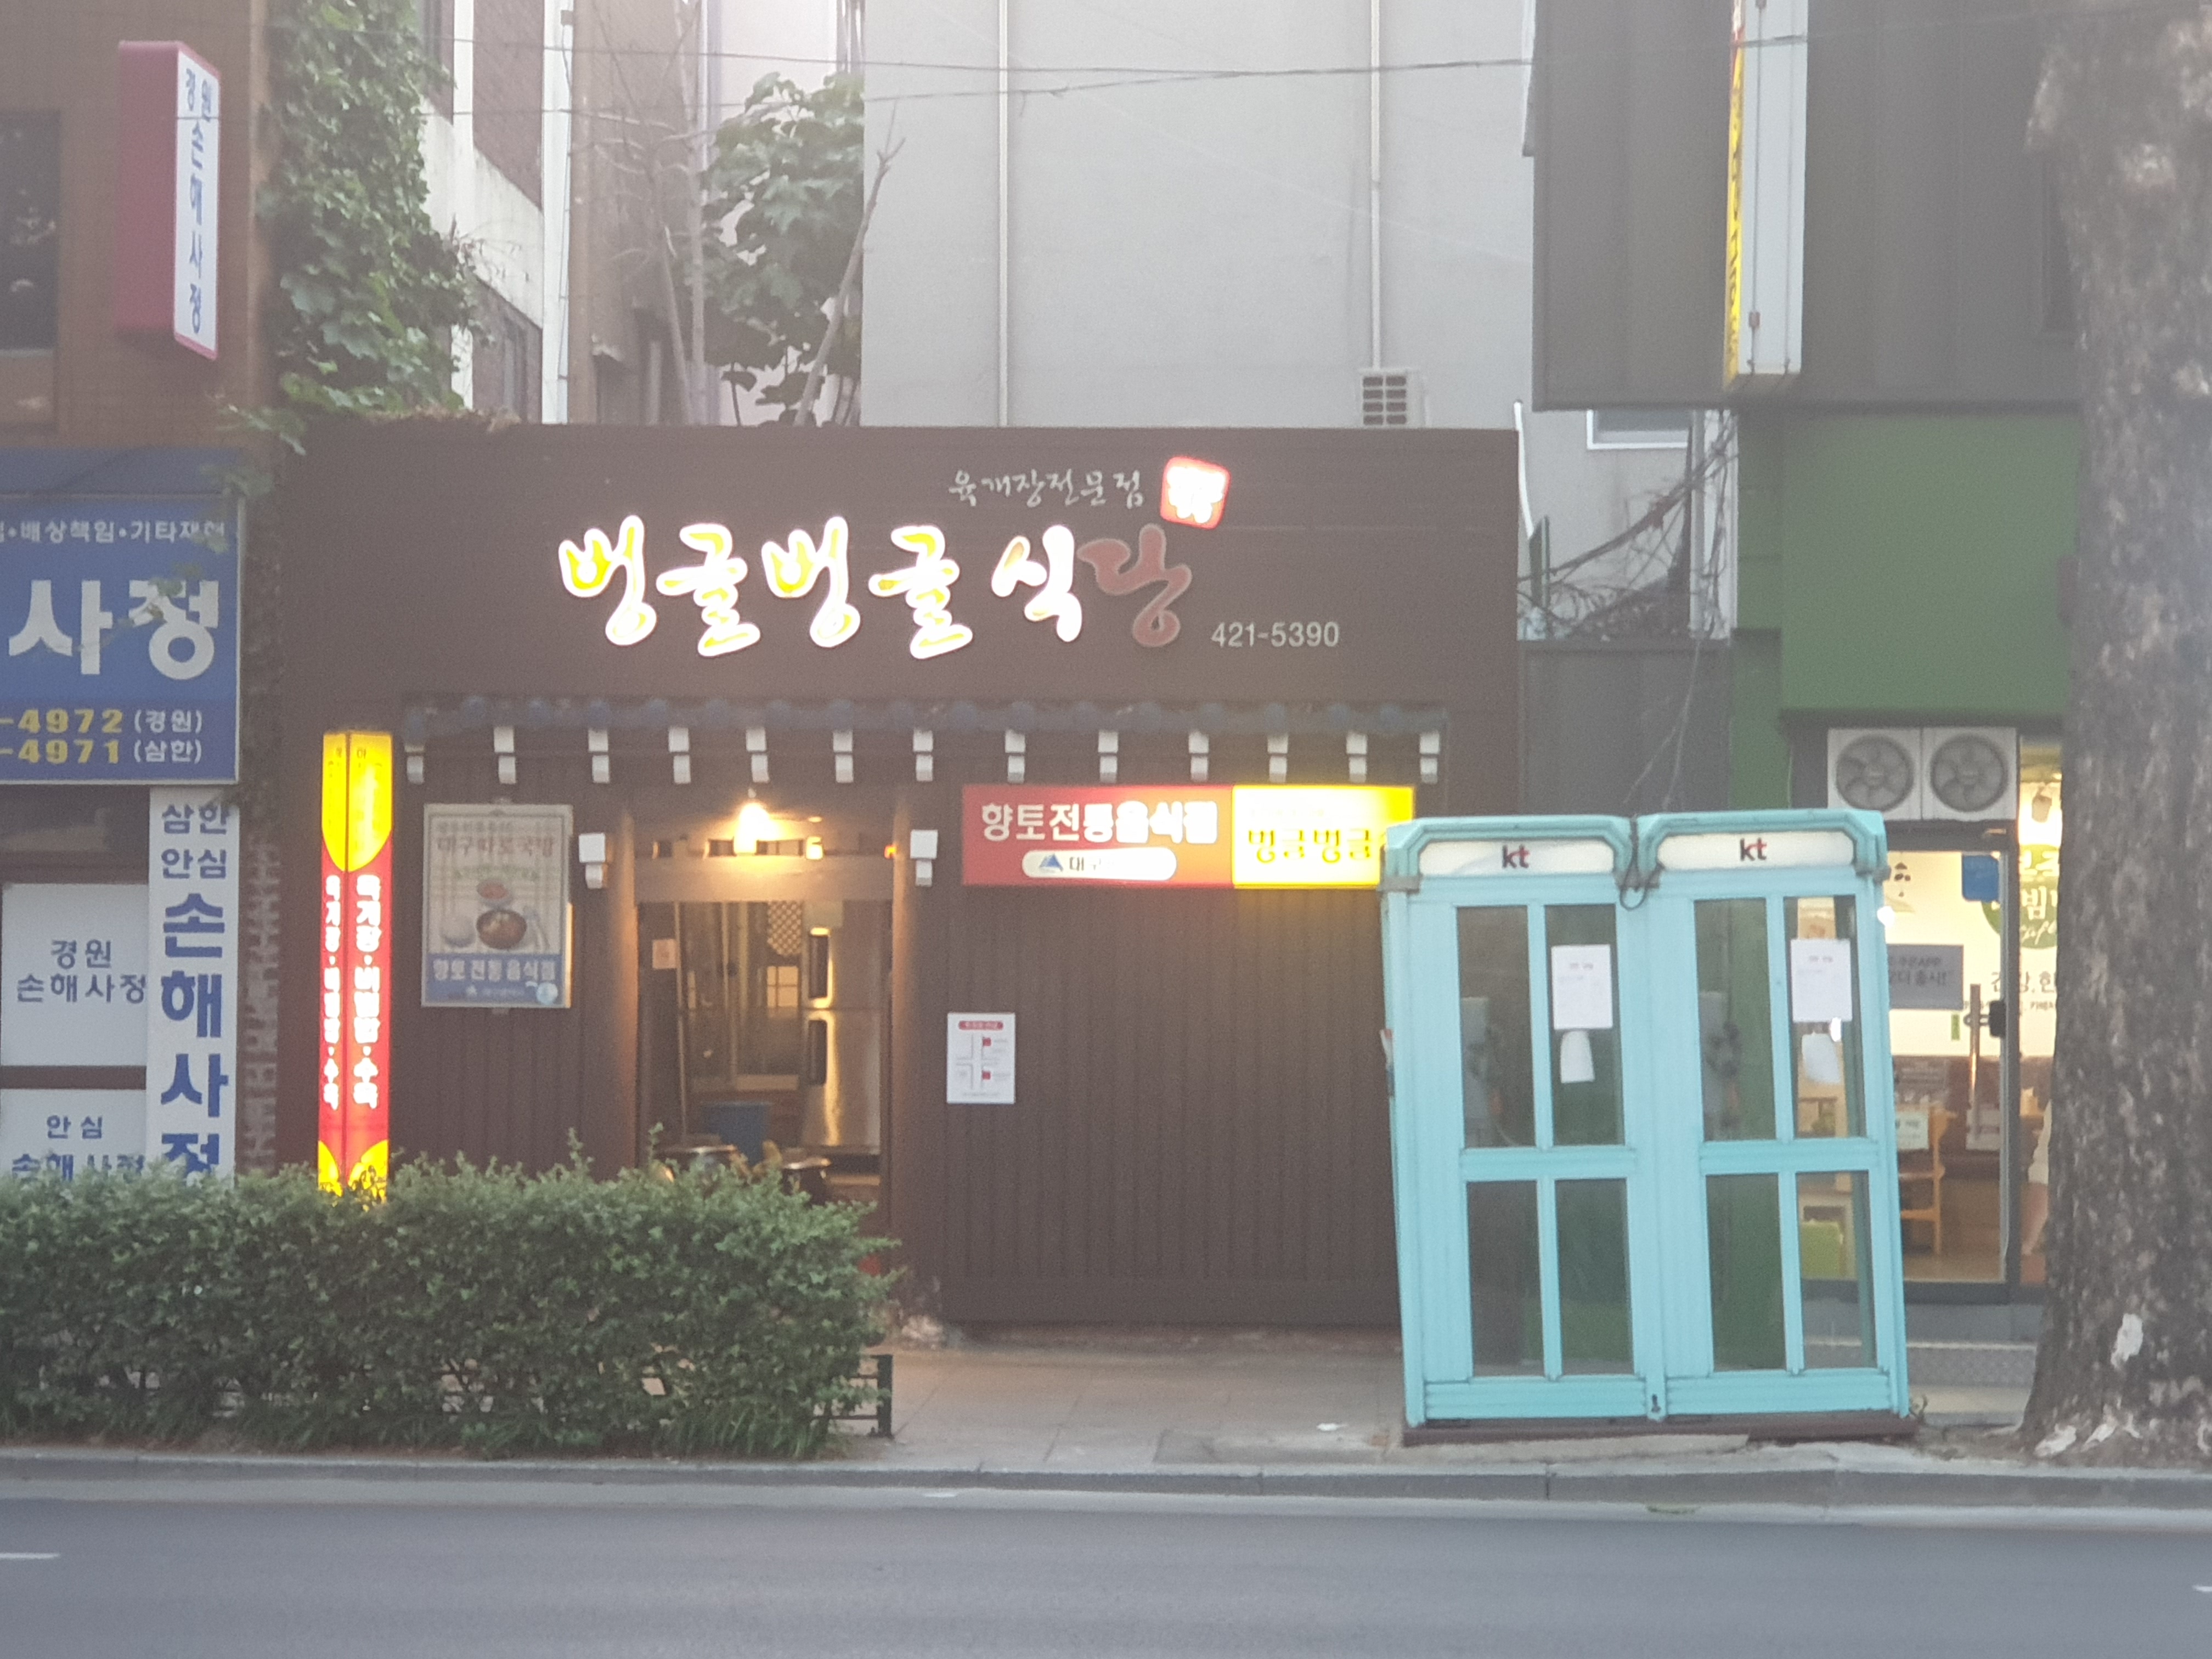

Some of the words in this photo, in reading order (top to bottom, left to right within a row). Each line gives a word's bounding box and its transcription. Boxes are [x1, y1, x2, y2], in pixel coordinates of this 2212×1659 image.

[1211, 621, 1340, 648] 421-5390
[1502, 844, 1530, 869] kt
[1740, 838, 1767, 861] kt
[161, 848, 227, 879] 안심
[51, 939, 112, 970] 경원
[17, 973, 147, 1004] 손해사정
[47, 1115, 103, 1139] 안심
